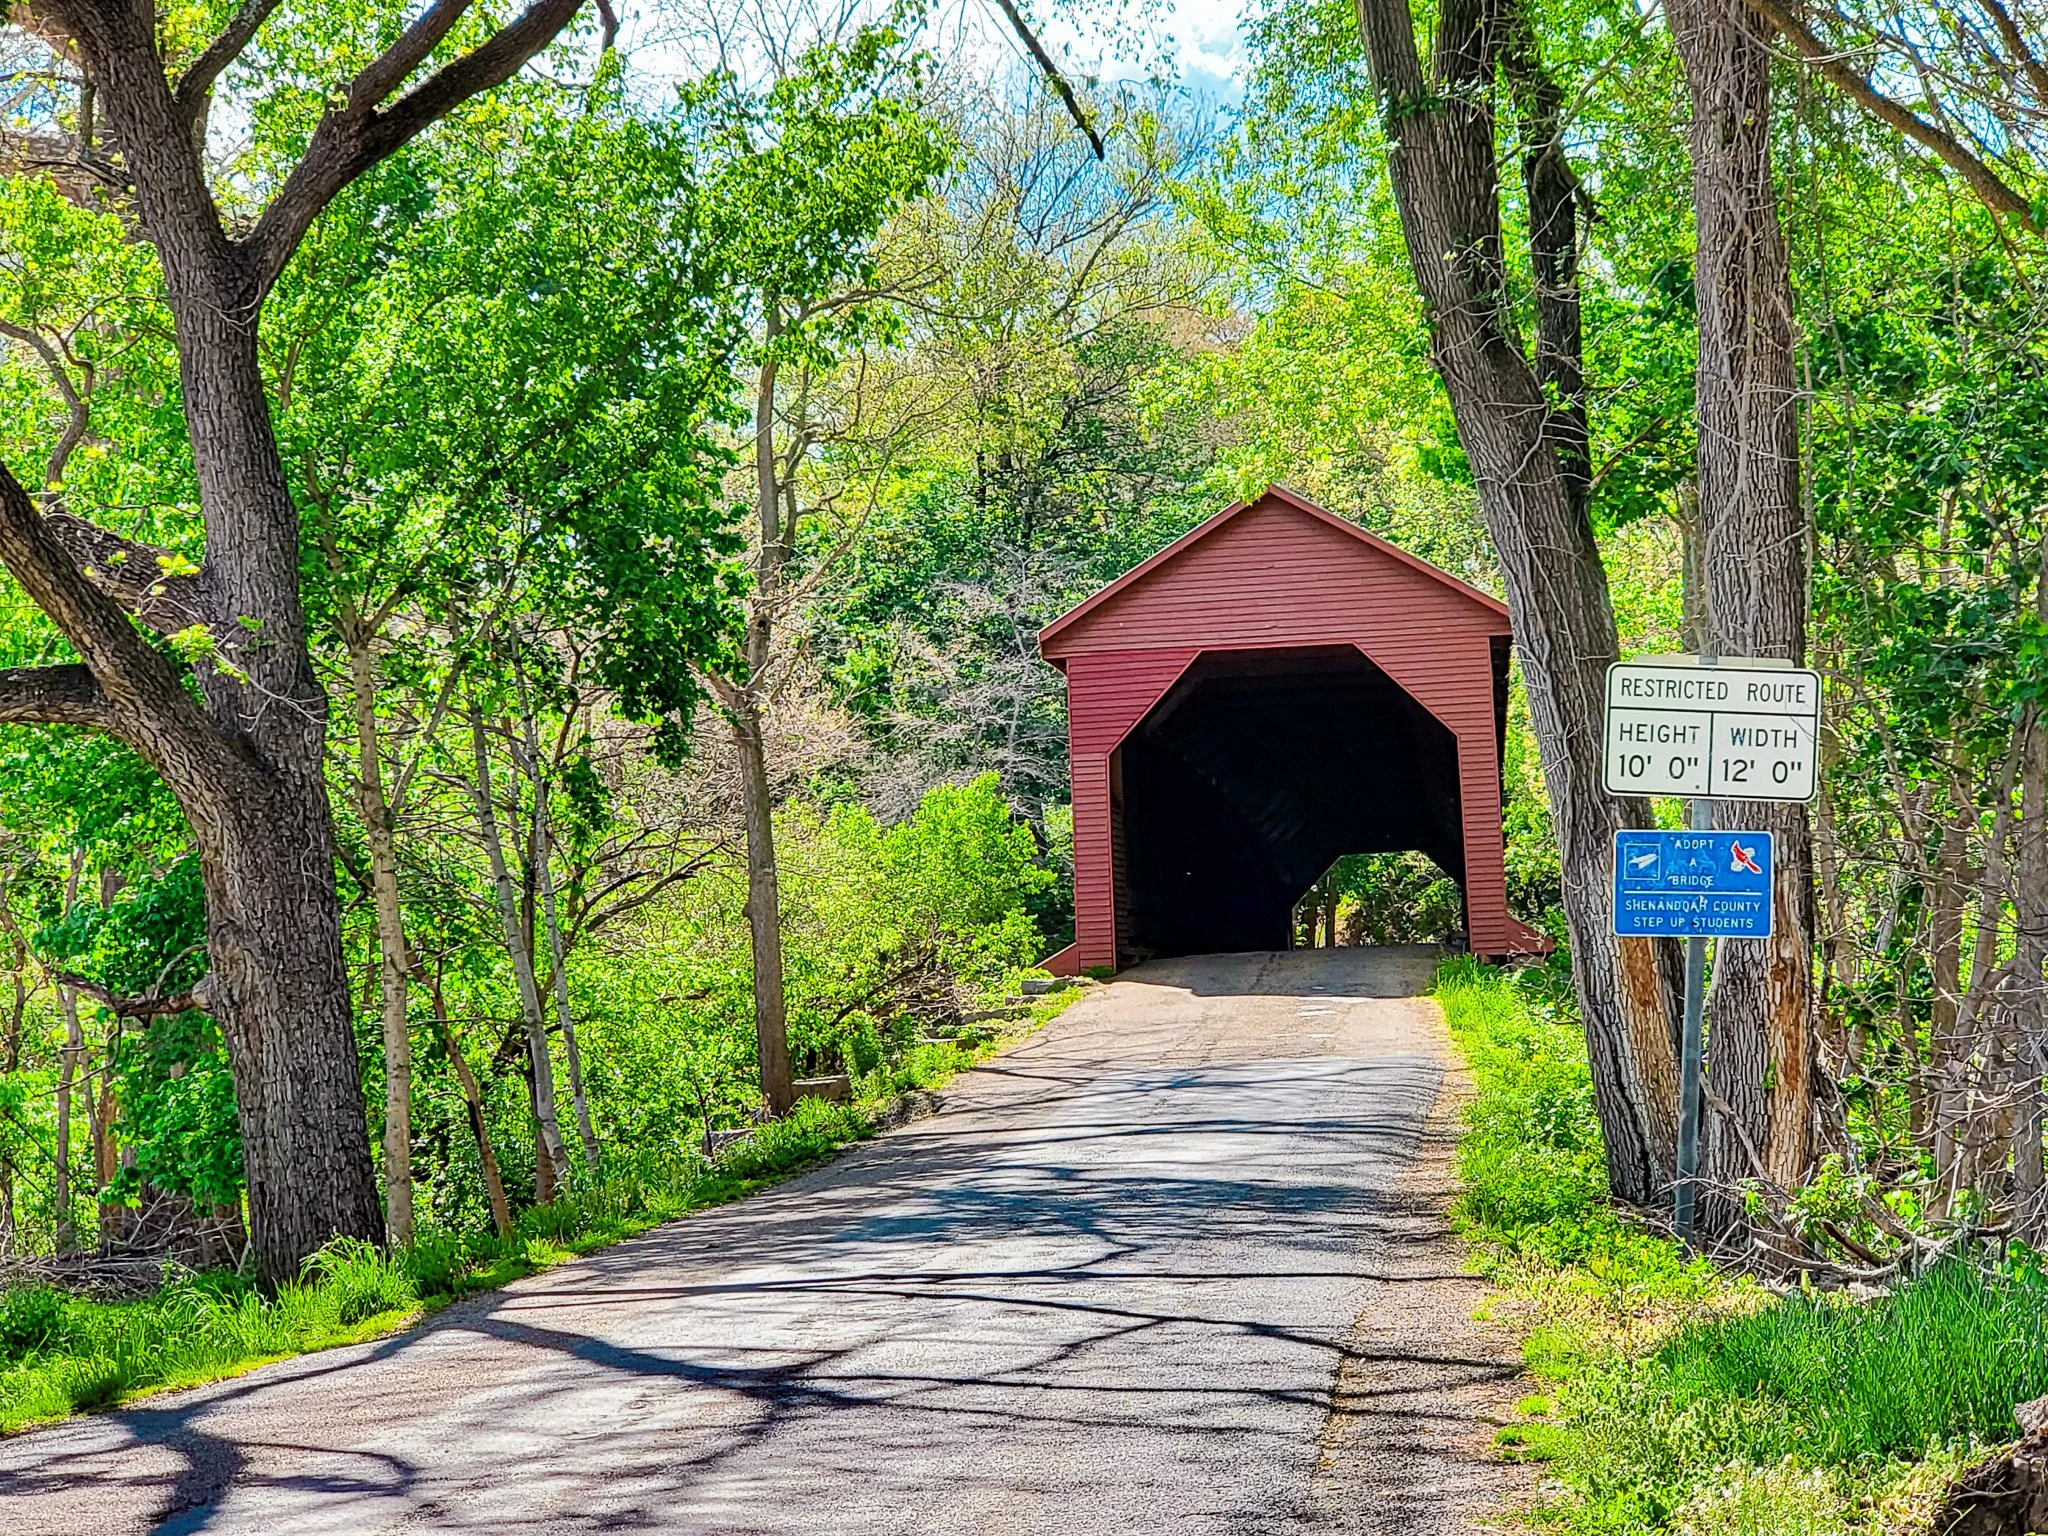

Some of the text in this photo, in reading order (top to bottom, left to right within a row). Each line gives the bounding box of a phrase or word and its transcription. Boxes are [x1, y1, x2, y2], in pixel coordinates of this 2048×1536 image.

[1620, 678, 1805, 703] RESTRICTED ROUTE
[1619, 723, 1700, 744] HEIGHT
[1730, 727, 1797, 748] WIDTH
[1619, 754, 1651, 777] 10'
[1722, 758, 1755, 782] 12'
[1674, 839, 1715, 849] ADOPT
[1689, 858, 1697, 868] A
[1671, 875, 1715, 886] BRIDGE
[1625, 900, 1761, 912] SHENANDOAH COUNTY
[1633, 917, 1754, 929] STEP UP STUDENTS
